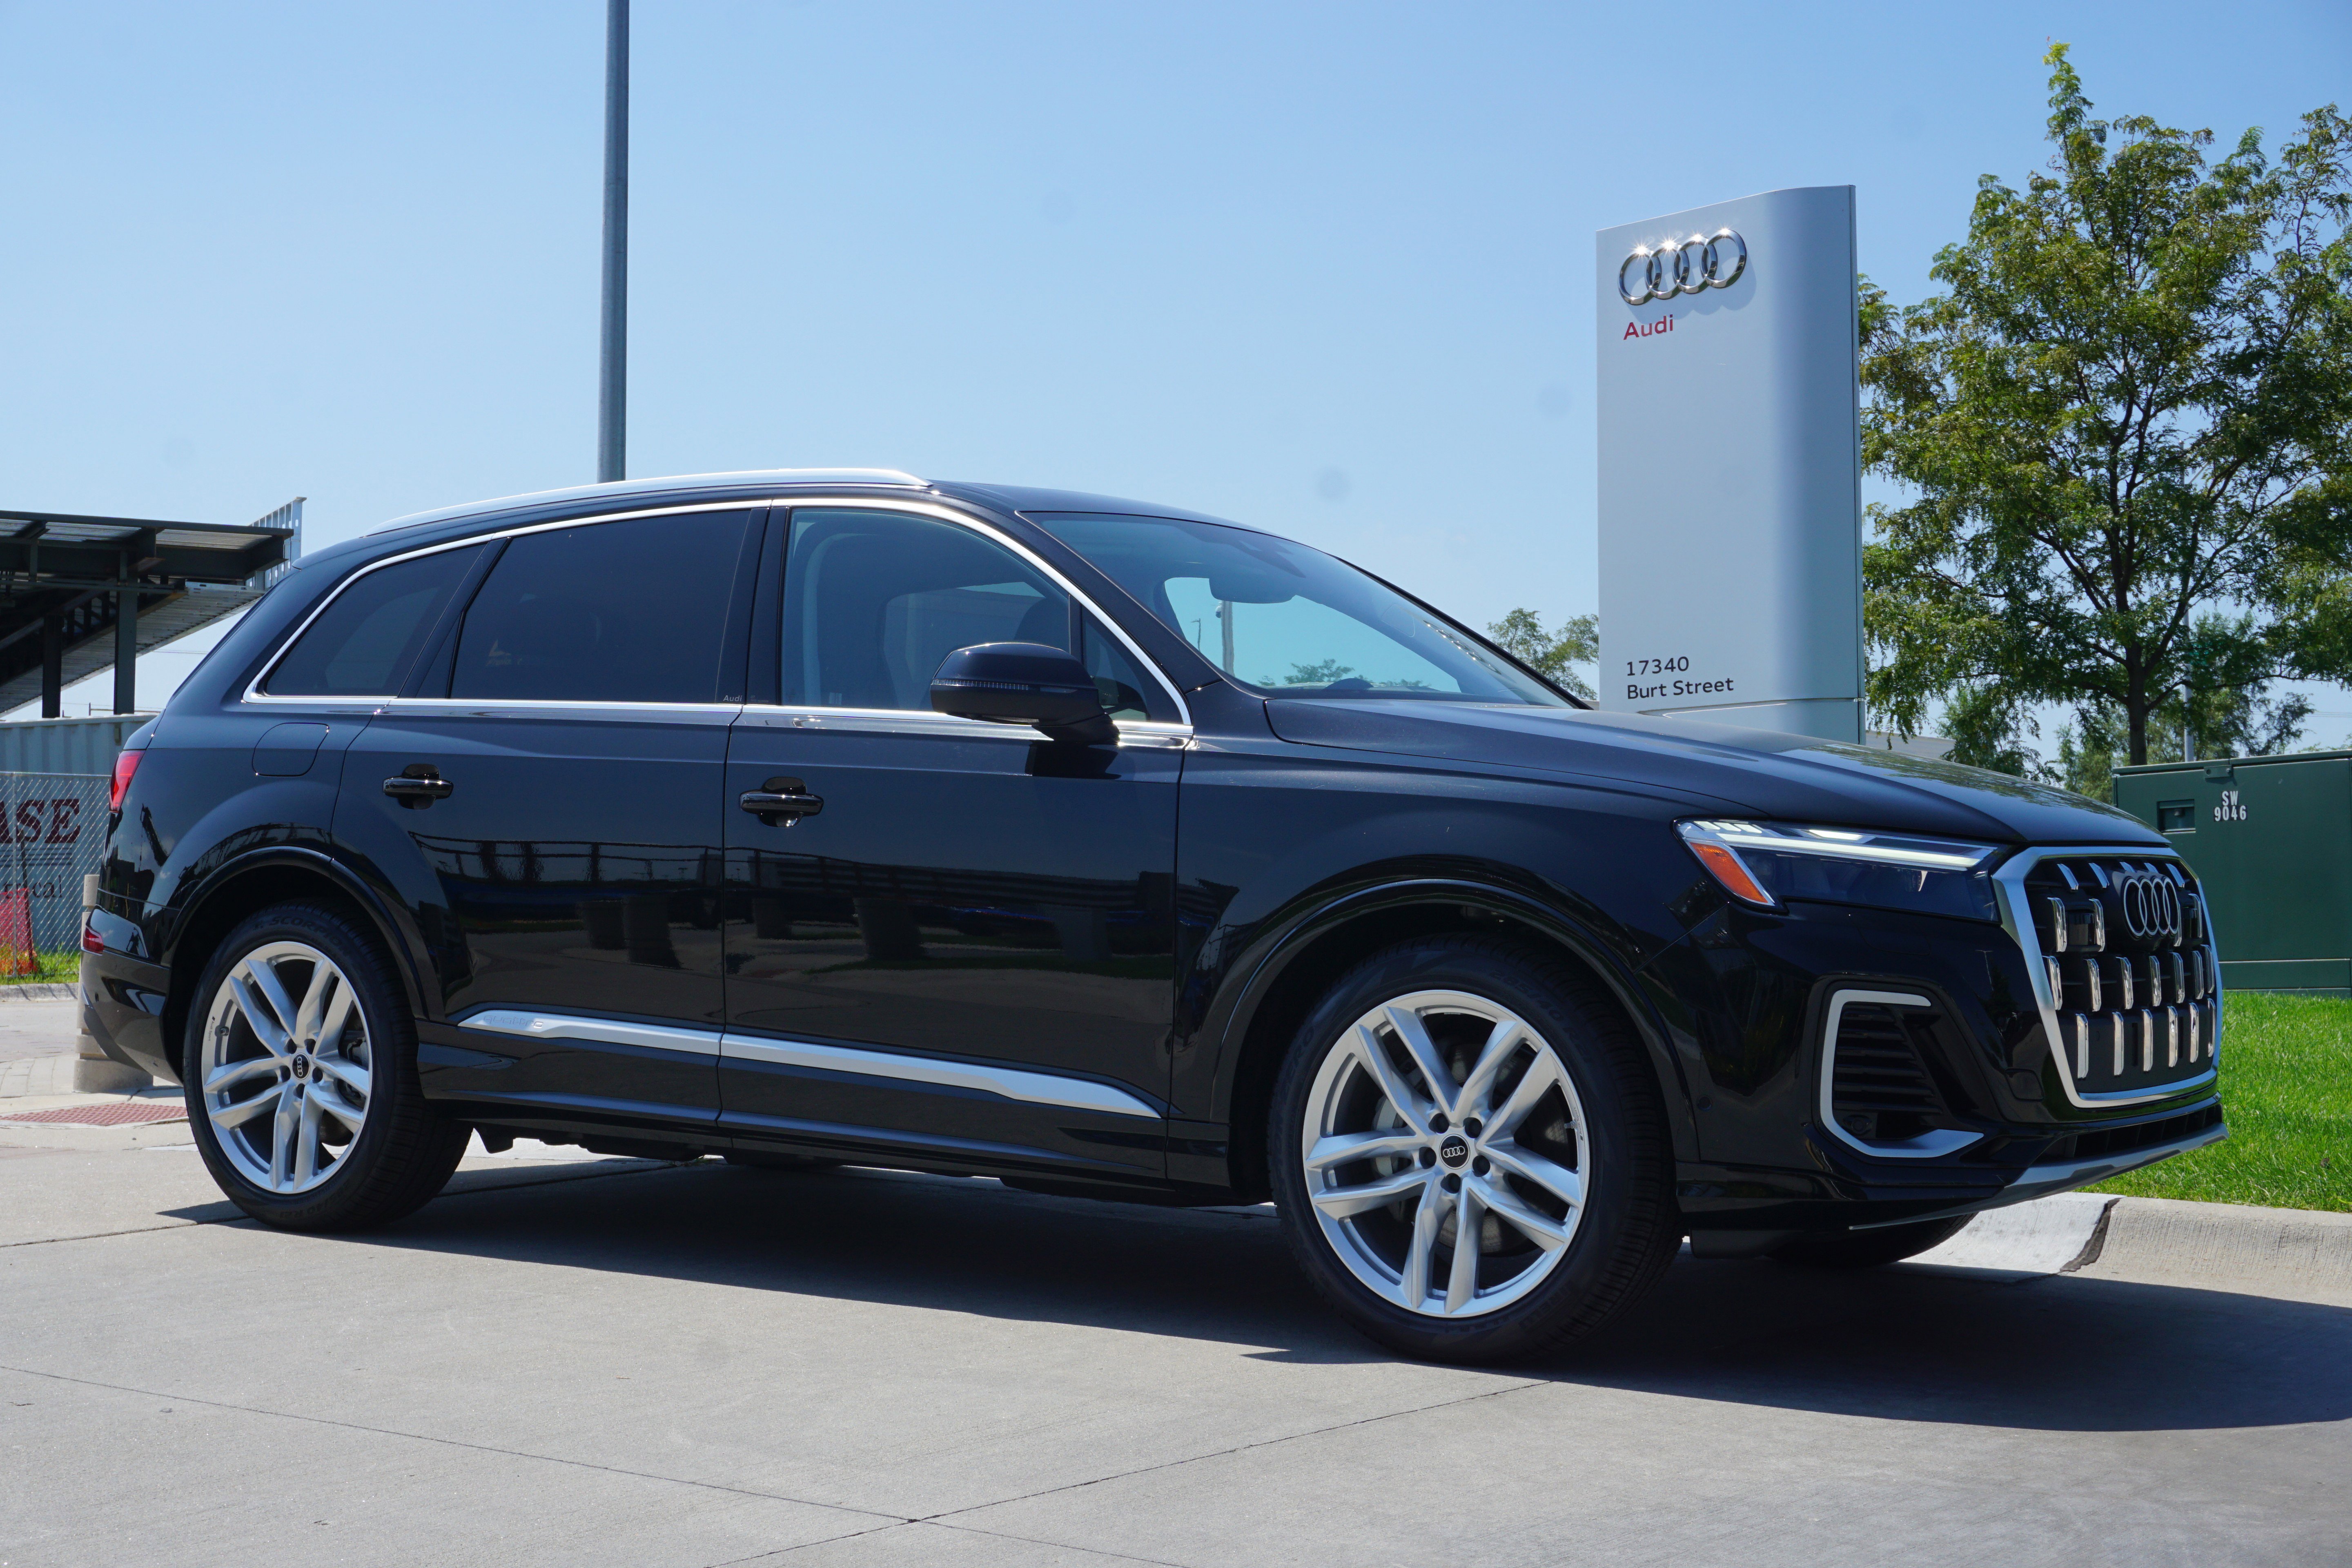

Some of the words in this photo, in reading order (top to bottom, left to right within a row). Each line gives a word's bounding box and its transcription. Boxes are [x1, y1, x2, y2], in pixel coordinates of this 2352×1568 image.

[1624, 314, 1673, 340] Audi
[1627, 656, 1689, 676] 17340
[1628, 684, 1667, 699] Burt
[1673, 678, 1734, 695] Street
[2222, 791, 2238, 806] SW
[2214, 806, 2247, 822] 9046
[483, 1015, 543, 1028] quattro
